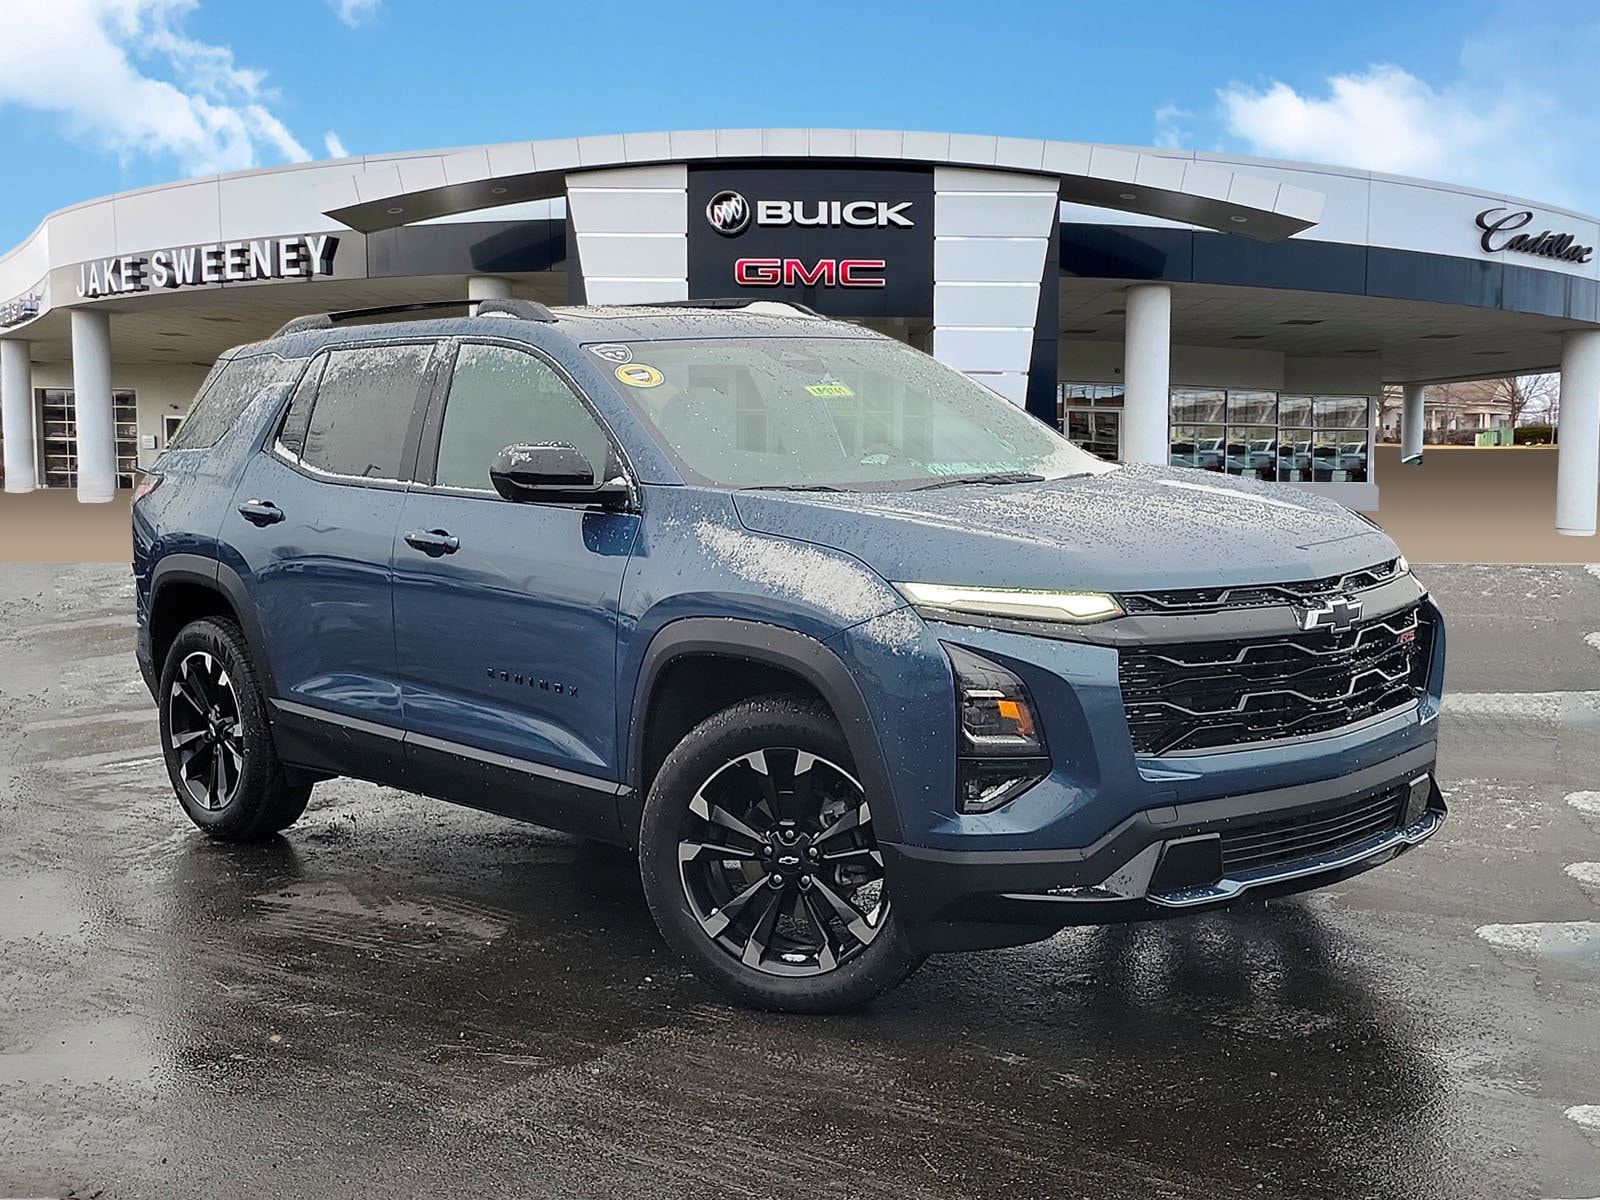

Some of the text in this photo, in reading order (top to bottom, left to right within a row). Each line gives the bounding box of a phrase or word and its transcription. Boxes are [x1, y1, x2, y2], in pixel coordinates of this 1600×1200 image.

[757, 200, 915, 226] BUICK
[1475, 207, 1593, 263] Cadillac
[76, 235, 333, 298] JAKE SWEENEY
[735, 258, 885, 287] GMC
[486, 667, 579, 698] EQUINOX
